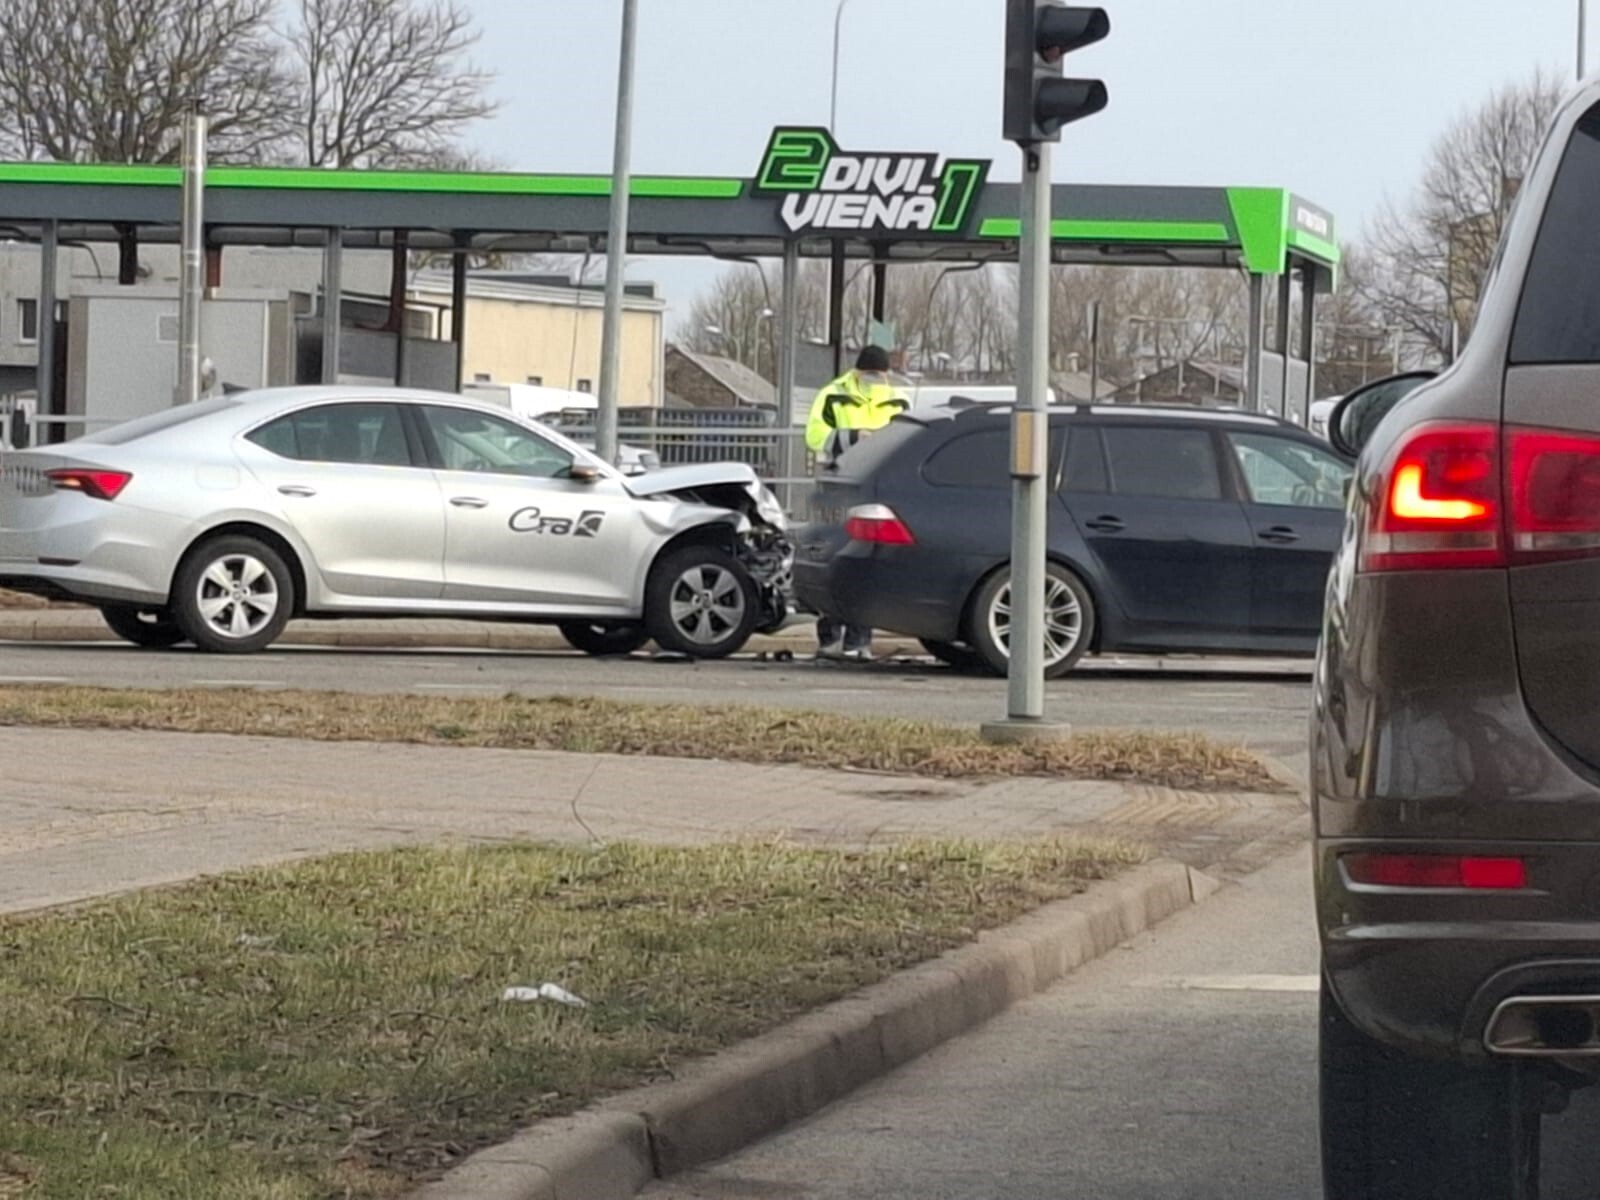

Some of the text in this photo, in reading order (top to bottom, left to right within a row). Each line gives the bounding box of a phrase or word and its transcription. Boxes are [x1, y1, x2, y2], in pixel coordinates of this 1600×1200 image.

[759, 131, 926, 197] 2 DIVI
[932, 164, 980, 230] 1
